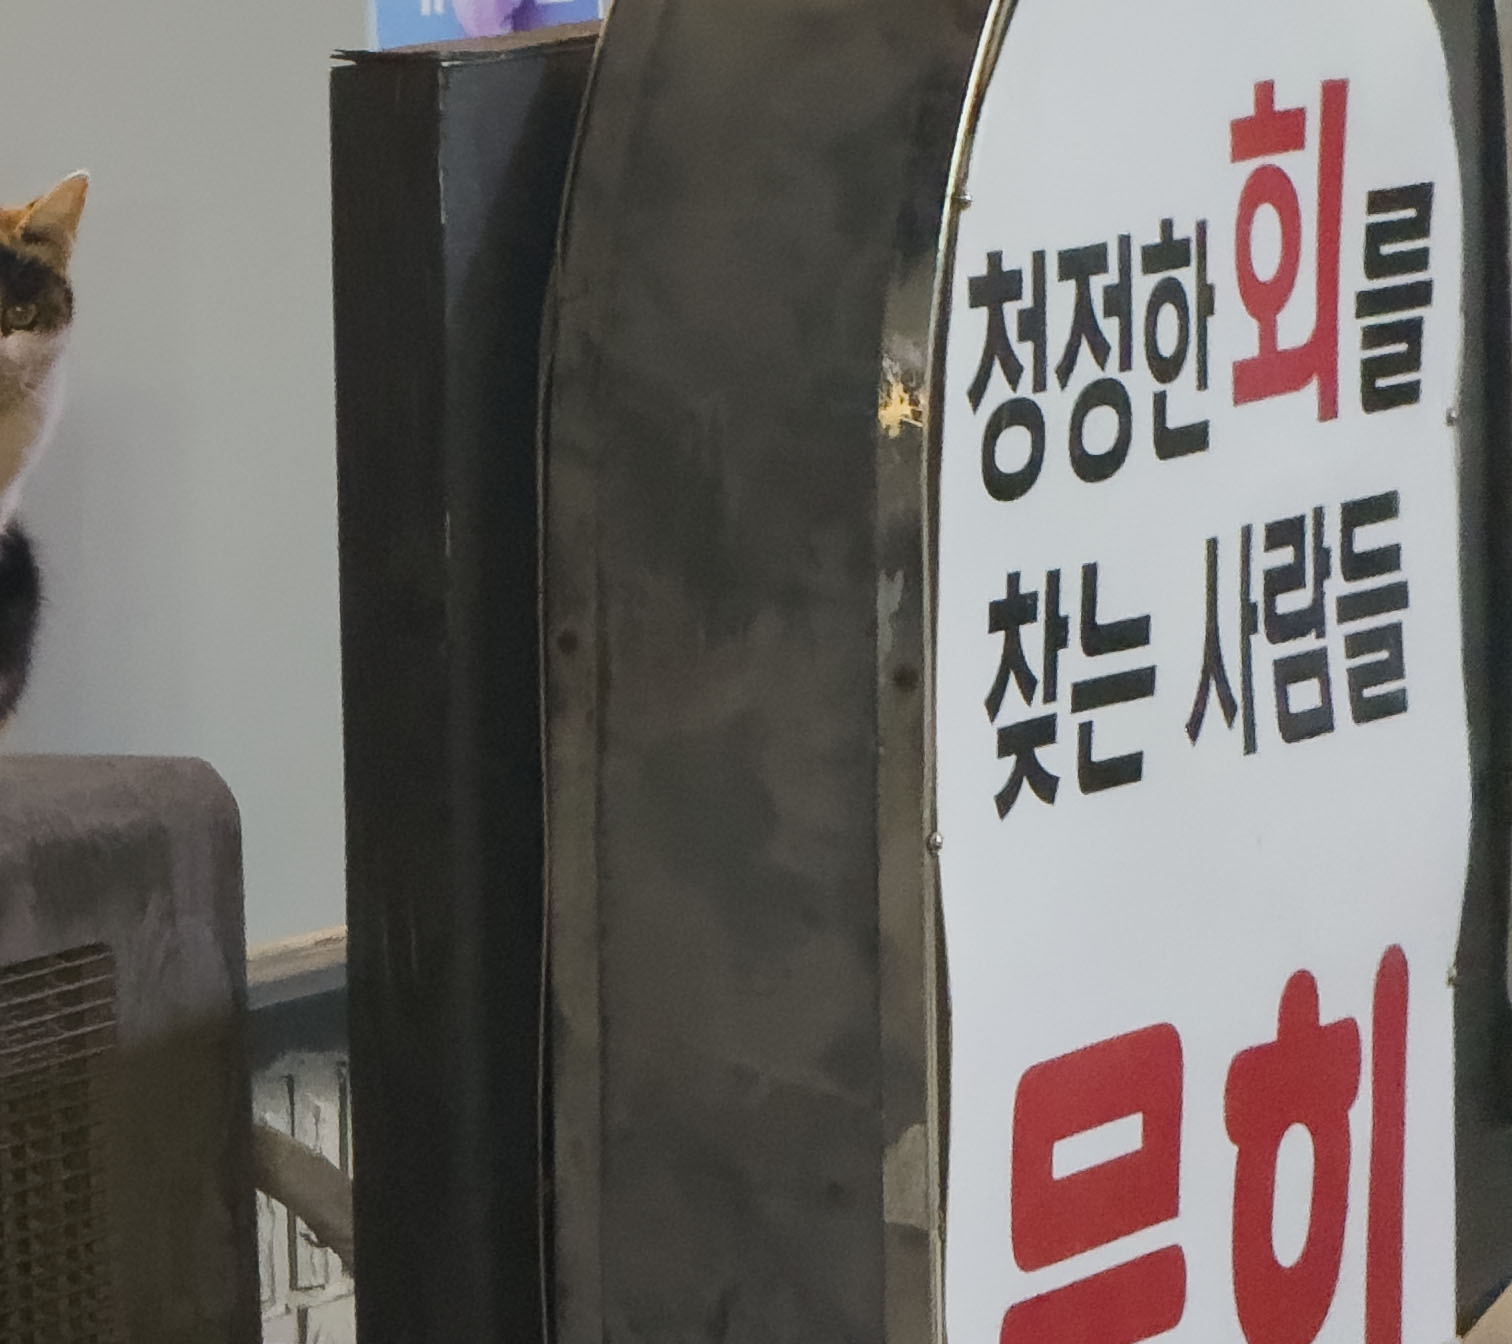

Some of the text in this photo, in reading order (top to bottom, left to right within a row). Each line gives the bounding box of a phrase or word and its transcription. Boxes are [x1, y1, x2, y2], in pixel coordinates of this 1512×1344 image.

[967, 78, 1436, 503] 청정한 회를
[986, 490, 1410, 820] 찾는 사람들
